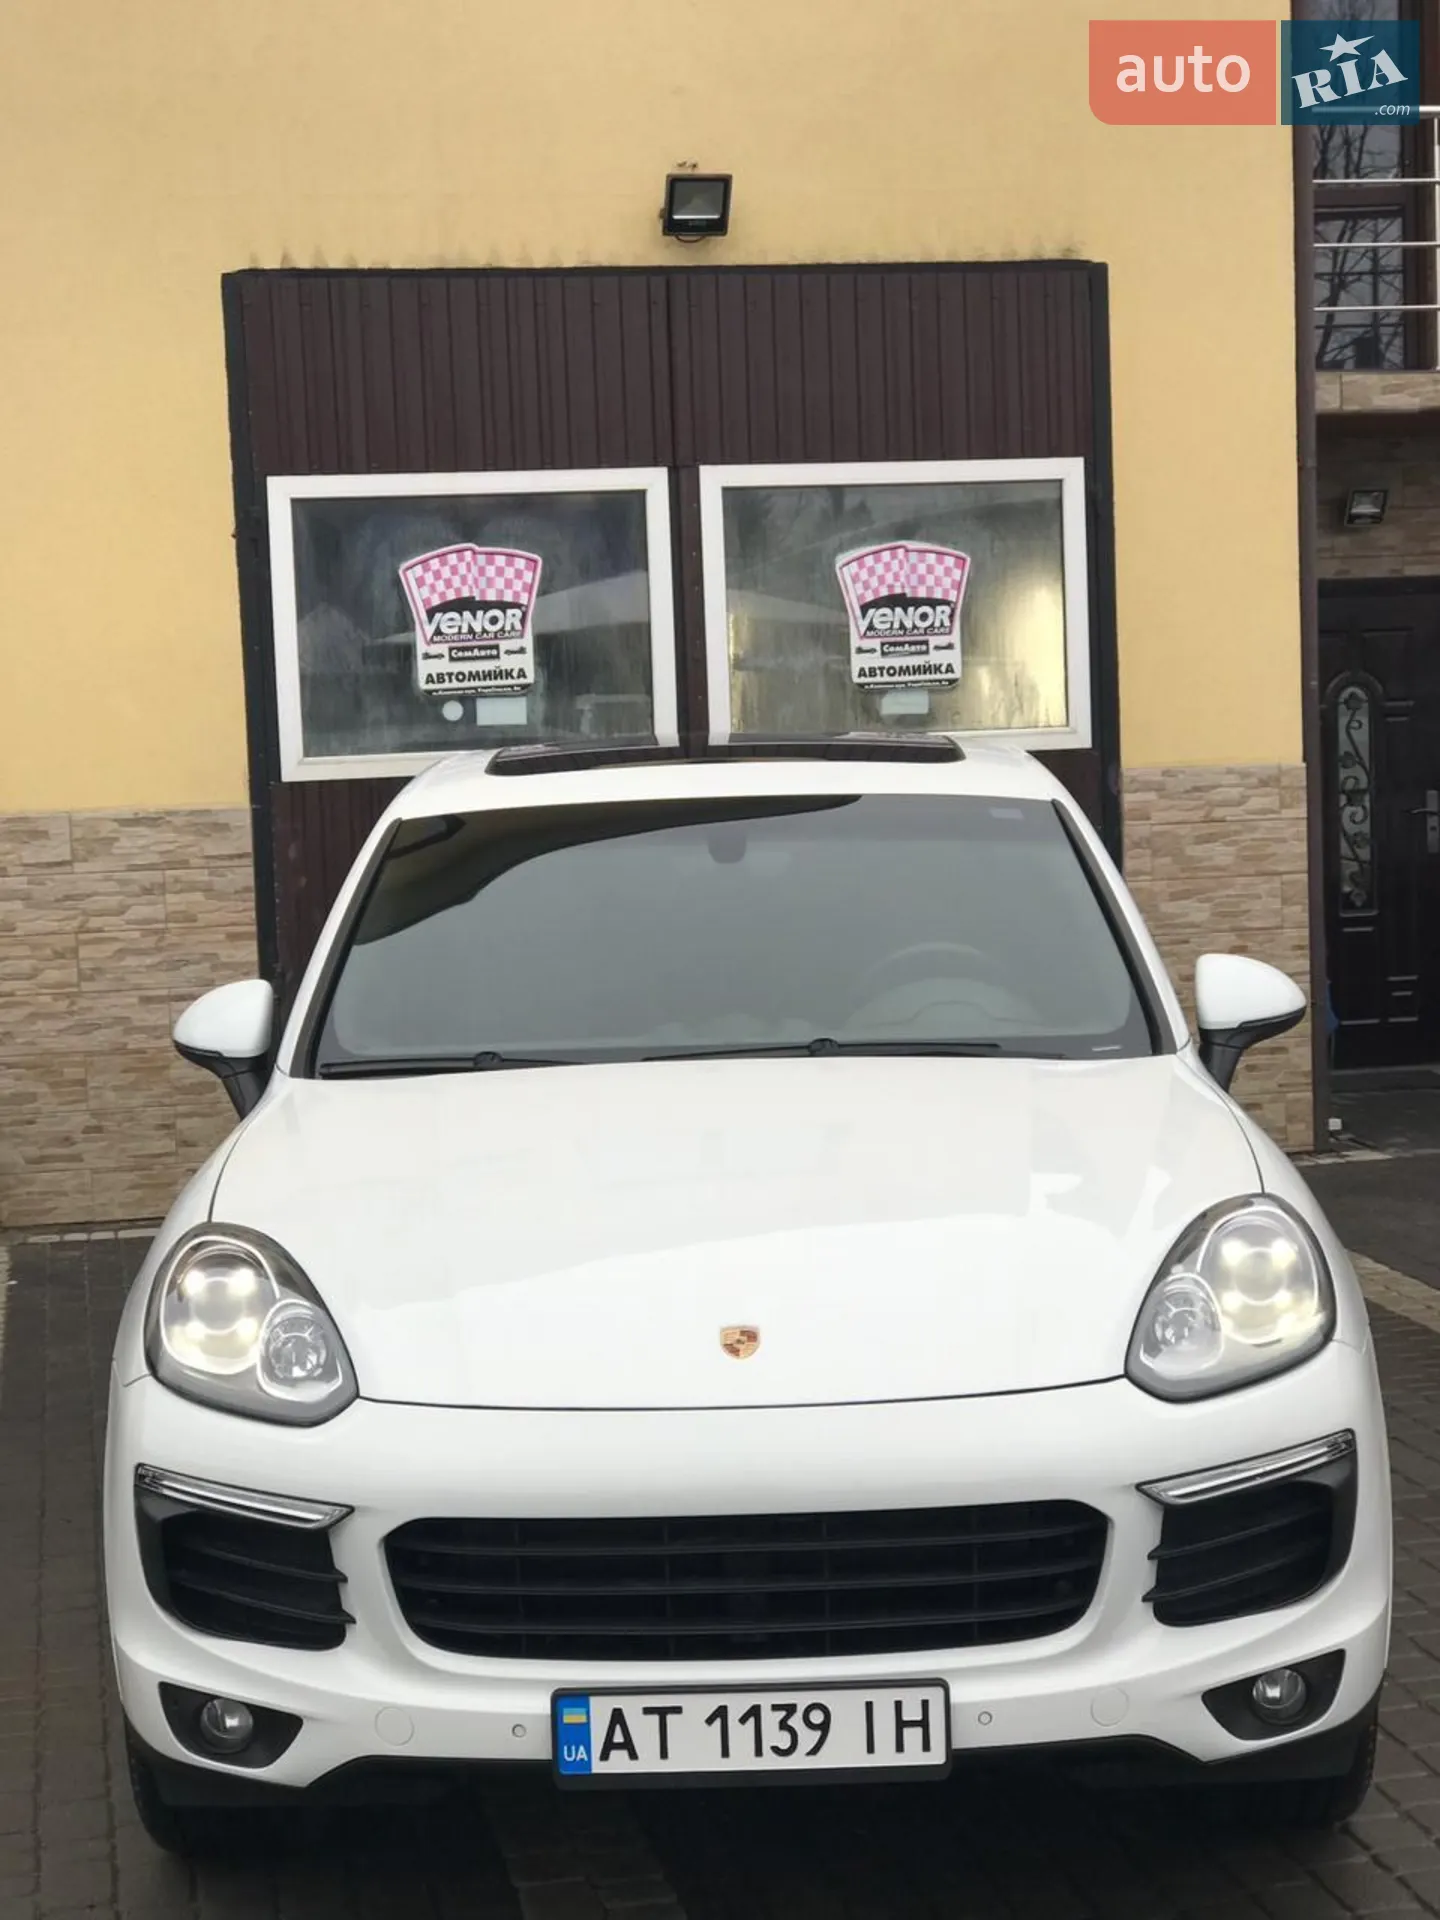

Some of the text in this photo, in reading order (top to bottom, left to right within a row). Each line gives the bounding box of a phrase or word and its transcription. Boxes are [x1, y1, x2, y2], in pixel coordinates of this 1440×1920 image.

[432, 630, 522, 642] MODERN CAR CARE
[906, 628, 925, 636] CAR
[425, 666, 528, 684] АВТОМИЙКА
[857, 660, 955, 678] АВТОМИЙКА
[599, 1699, 932, 1761] AT 1139 IH
[563, 1745, 588, 1762] UA
